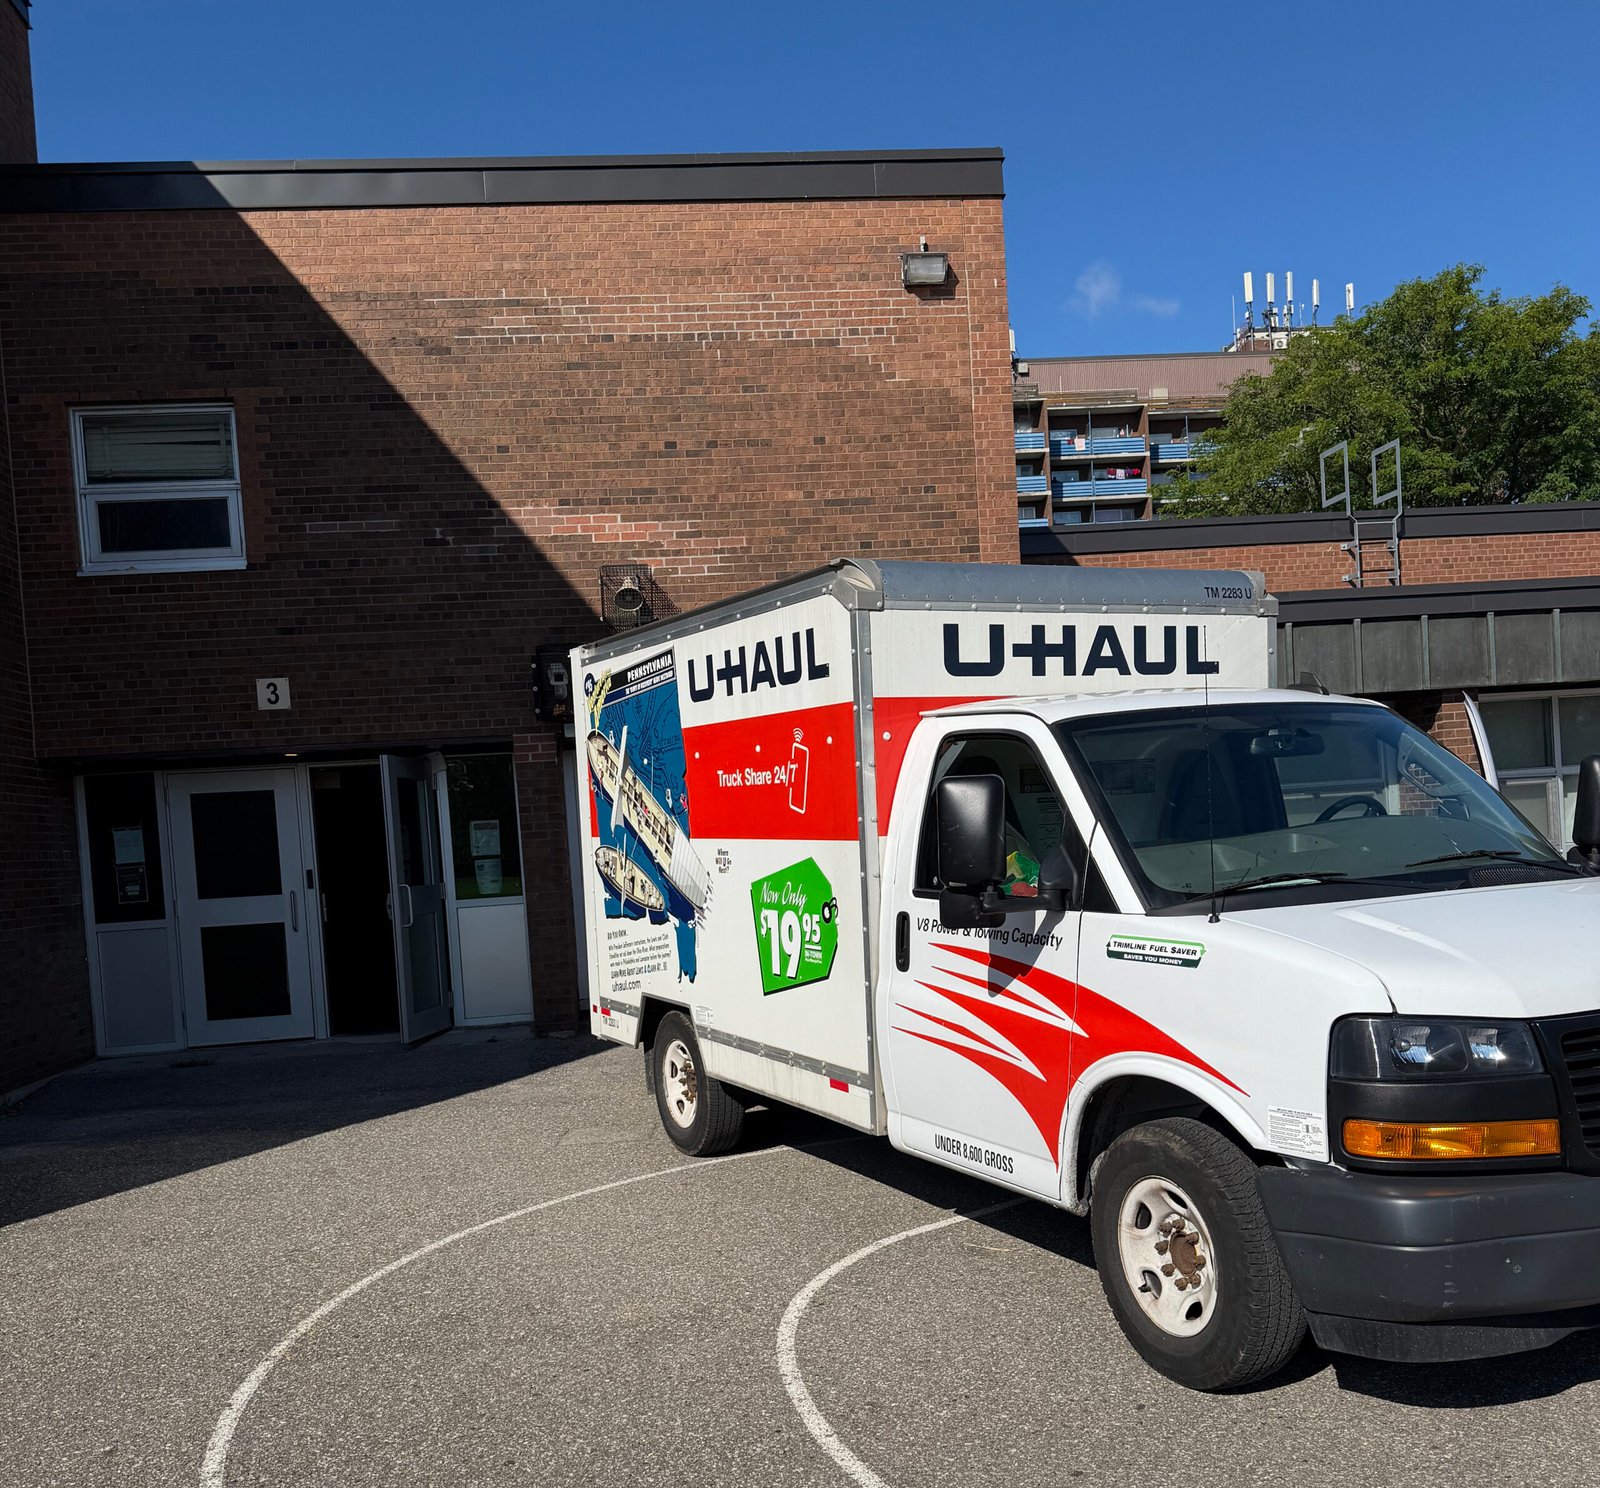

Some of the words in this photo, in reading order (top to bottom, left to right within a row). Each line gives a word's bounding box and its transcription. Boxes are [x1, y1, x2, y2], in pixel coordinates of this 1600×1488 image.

[1203, 586, 1219, 598] TM
[1221, 587, 1243, 599] 2283
[1244, 587, 1252, 599] U
[627, 654, 672, 682] PENNSYLVANIA
[266, 682, 280, 705] 3
[717, 769, 743, 787] Truck
[744, 768, 772, 786] Share
[761, 881, 780, 903] Now
[782, 881, 808, 916] Only
[917, 917, 930, 932] V8
[1011, 927, 1063, 951] Capacity
[1113, 941, 1147, 950] TRIMLINE
[1149, 945, 1168, 953] FUEL
[1171, 946, 1197, 956] SAVER
[612, 980, 641, 992] uhaul.com
[935, 1133, 962, 1156] UNDER
[963, 1143, 982, 1164] 8,600
[984, 1150, 1014, 1174] GROSS
